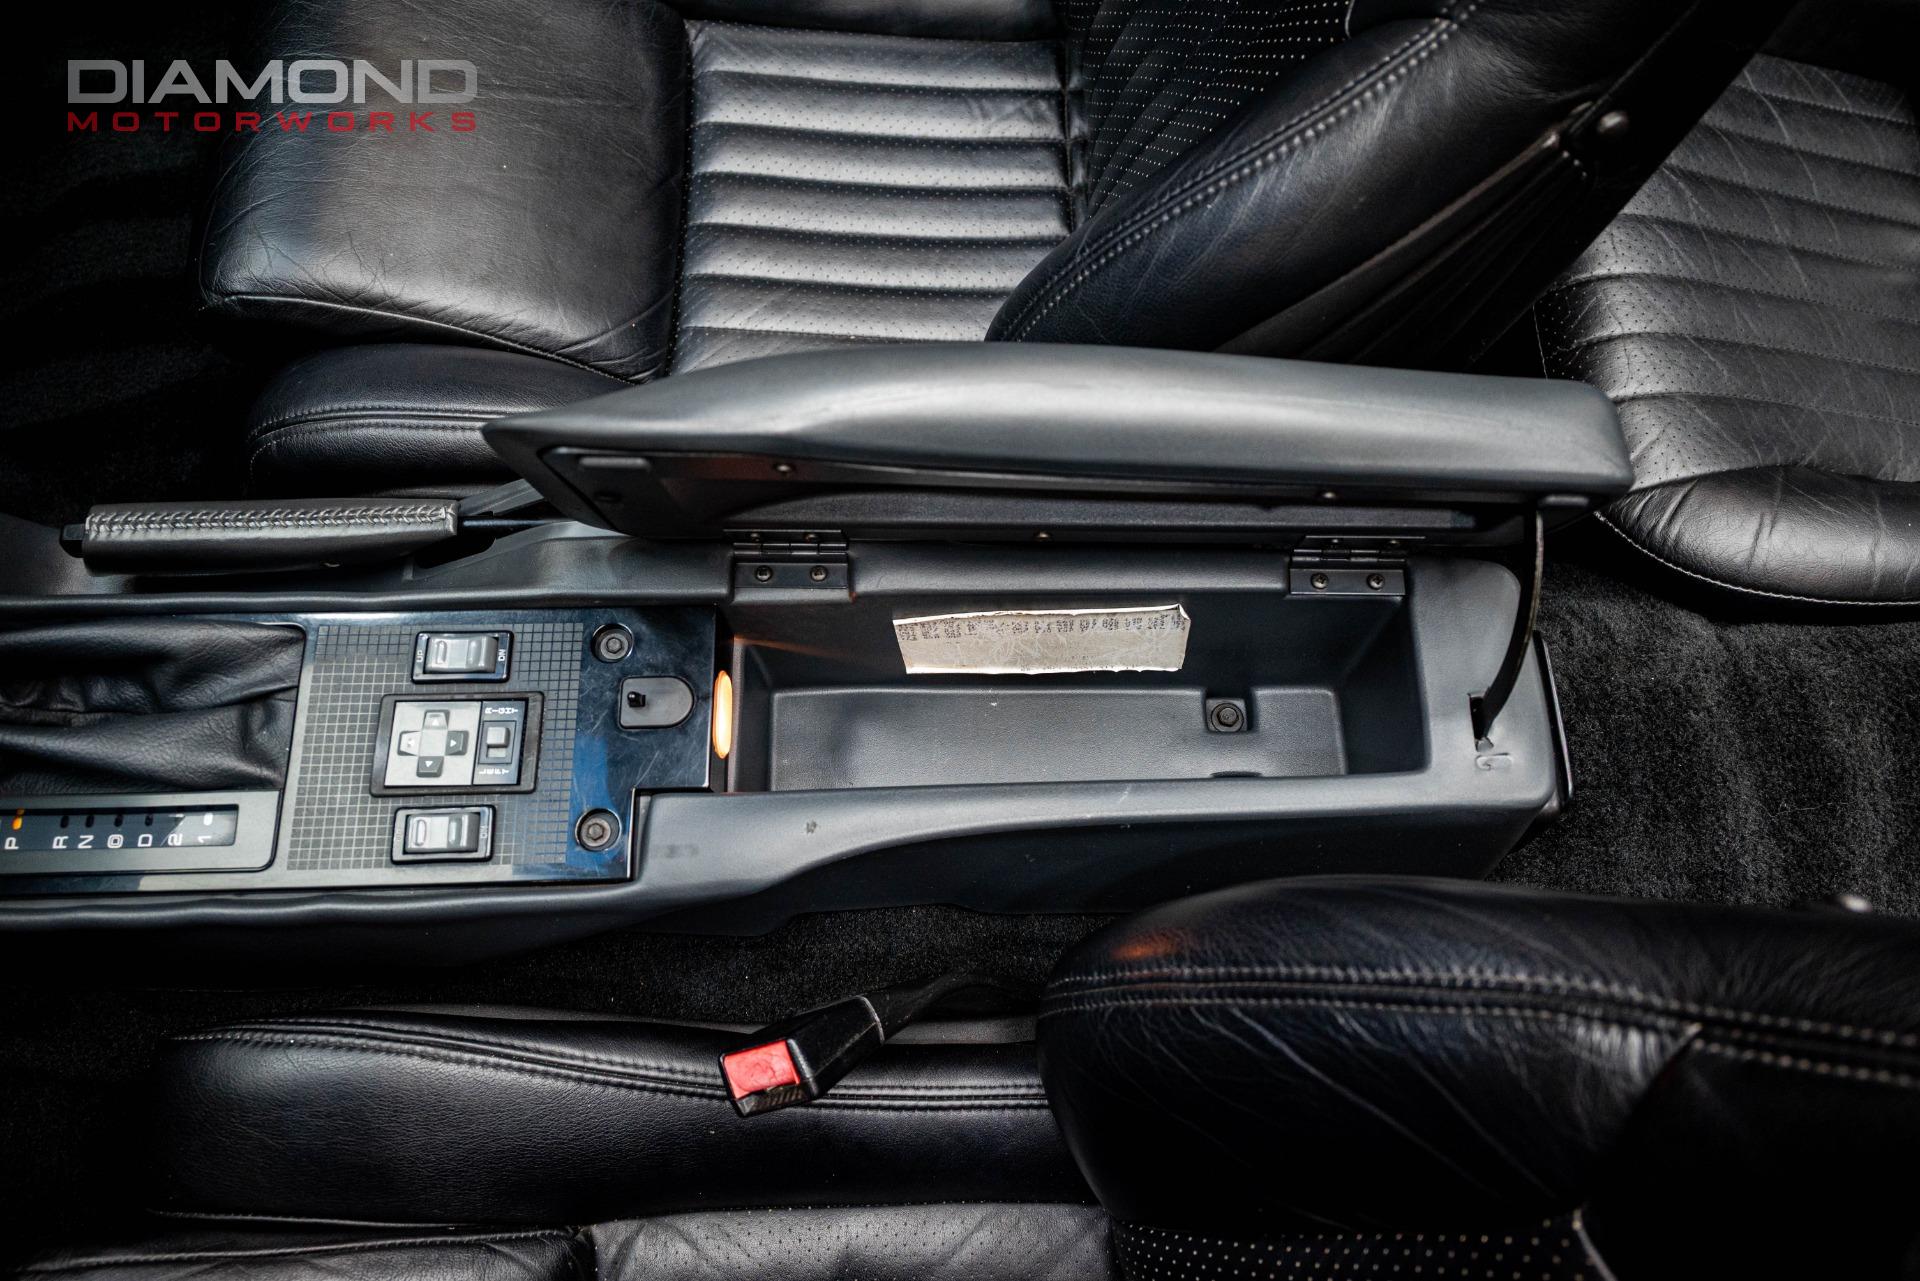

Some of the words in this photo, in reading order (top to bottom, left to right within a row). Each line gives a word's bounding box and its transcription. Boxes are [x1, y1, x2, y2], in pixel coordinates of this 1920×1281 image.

[416, 650, 425, 663] UP
[4, 837, 19, 850] P
[53, 836, 68, 849] R
[78, 835, 94, 848] N
[137, 834, 153, 847] D
[168, 833, 183, 846] 2
[198, 835, 212, 844] 1
